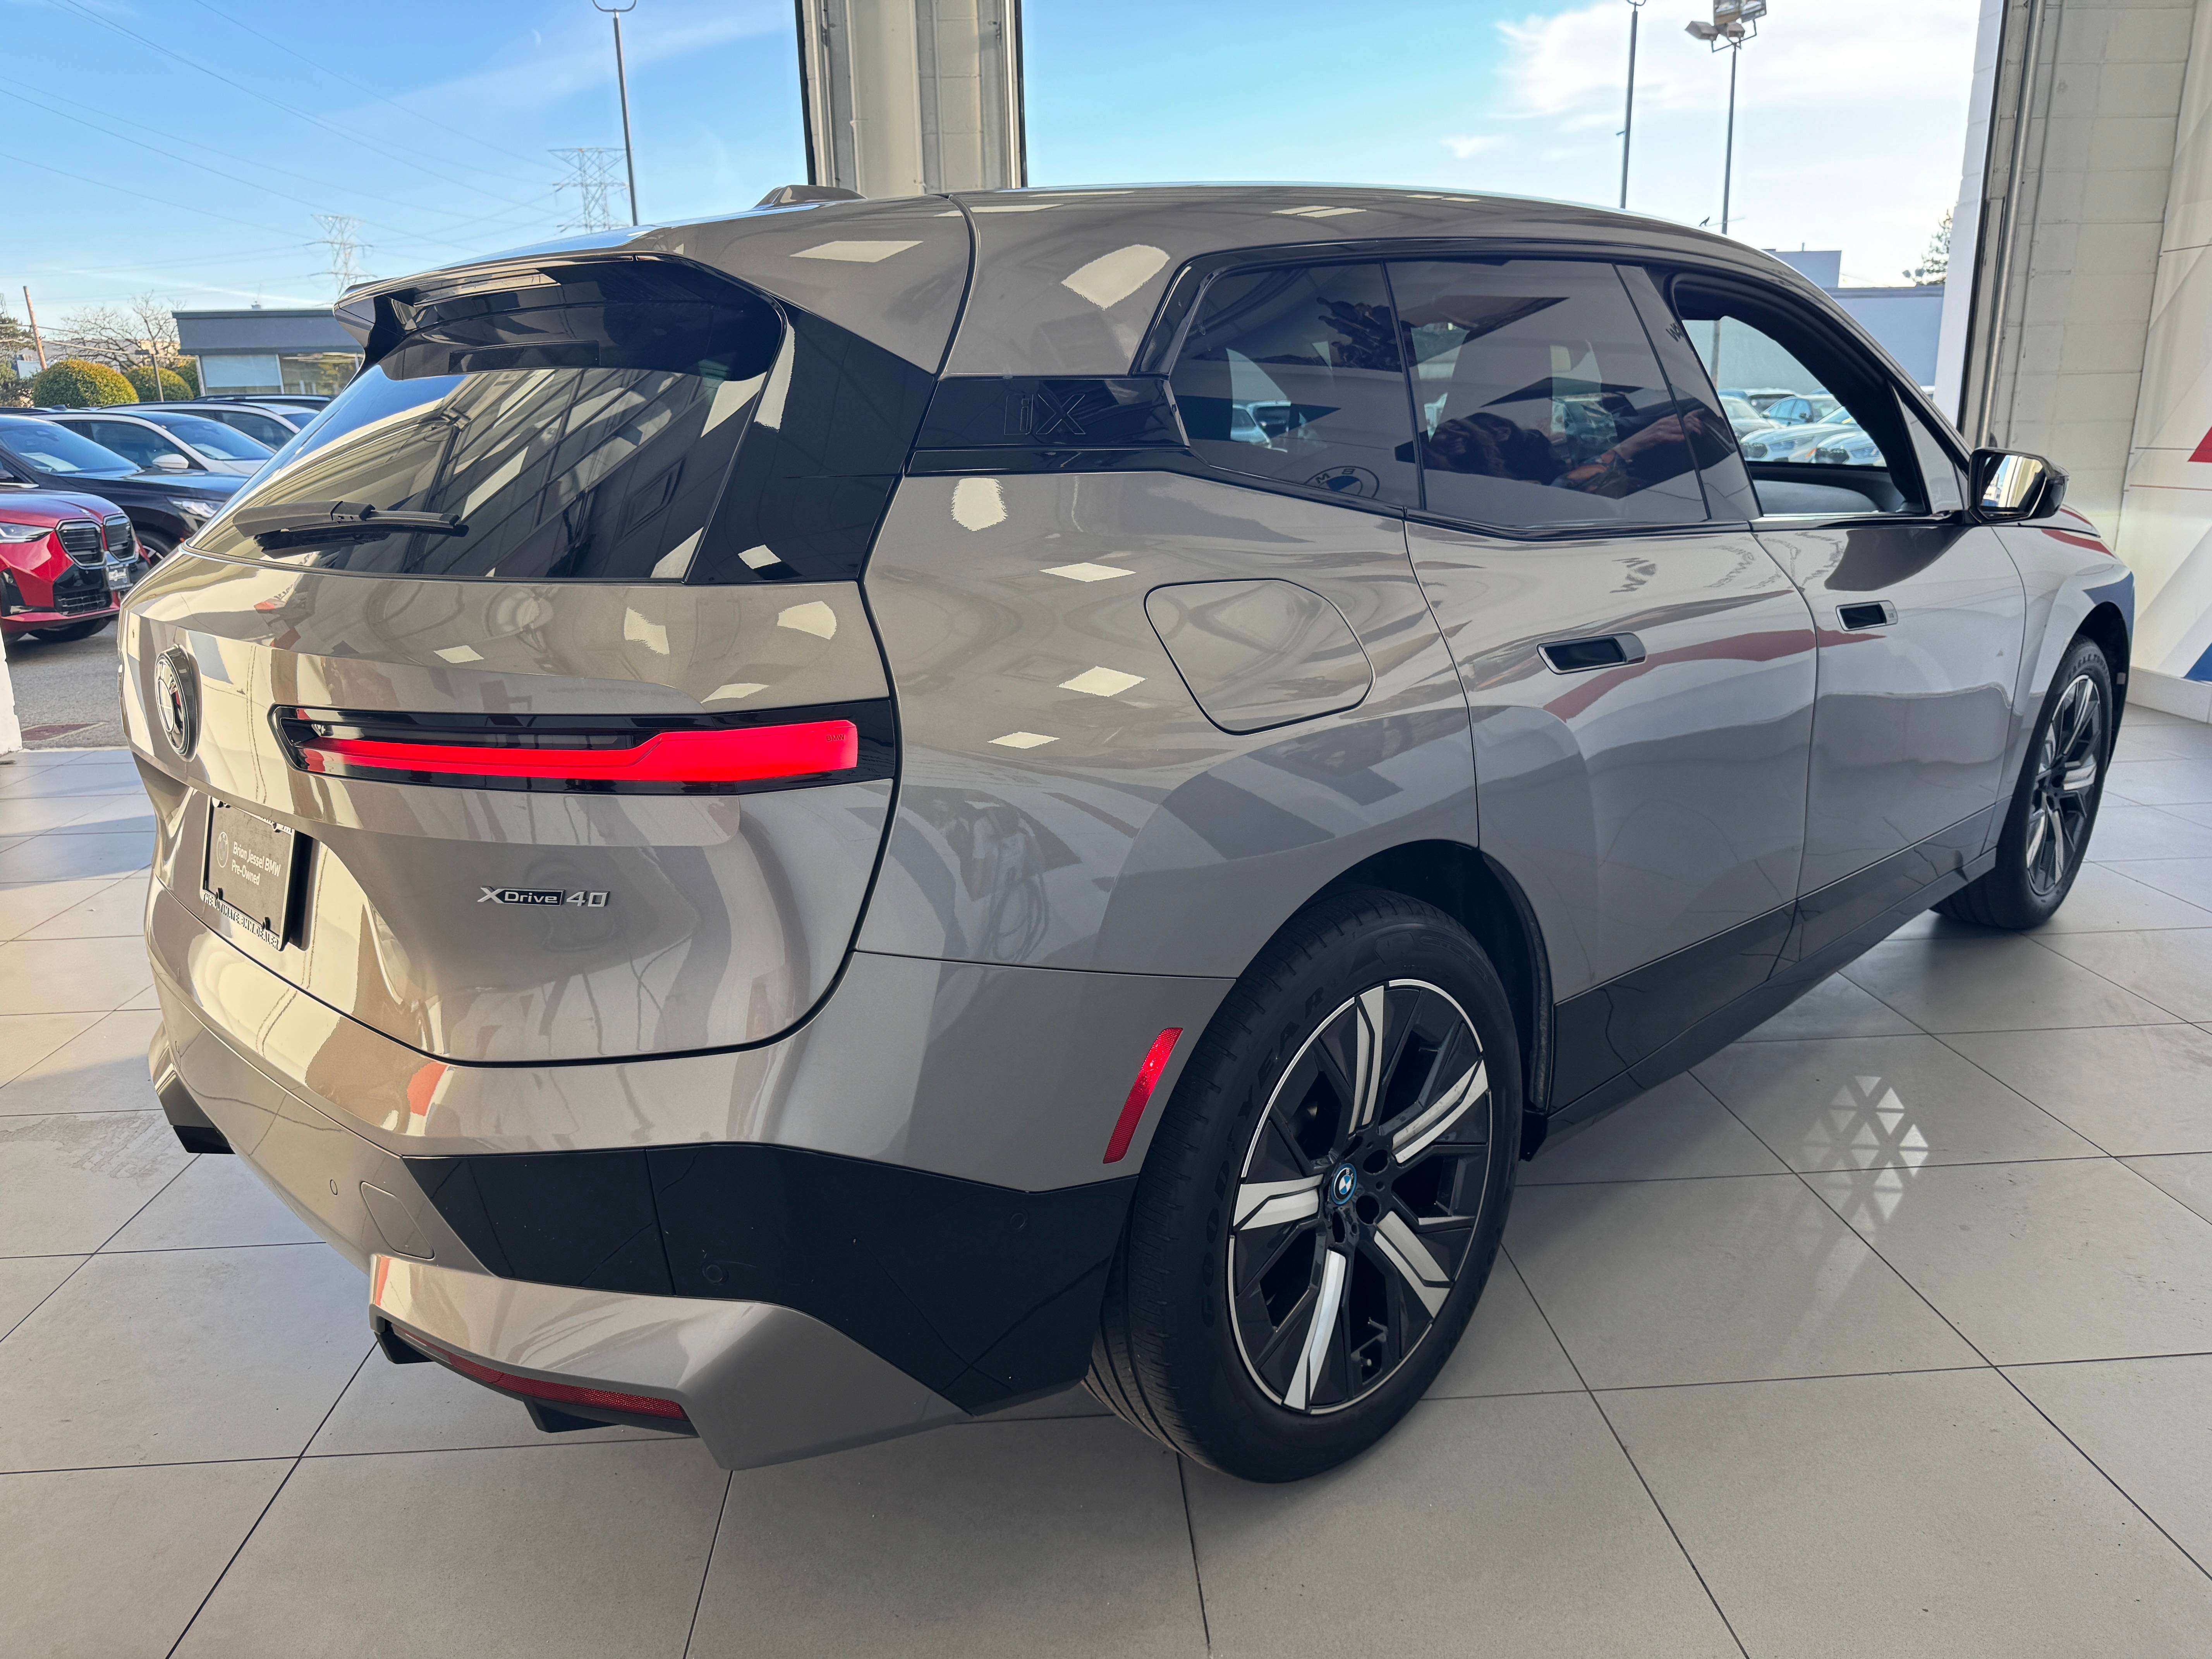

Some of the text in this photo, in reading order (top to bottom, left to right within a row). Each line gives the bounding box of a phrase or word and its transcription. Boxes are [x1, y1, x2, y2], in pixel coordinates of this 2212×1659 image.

[826, 733, 845, 742] BMW
[231, 859, 261, 886] Pre-Owned
[233, 841, 281, 877] Brian Jessel BMW
[203, 892, 279, 950] THE ULTIMATE BMW DEALER
